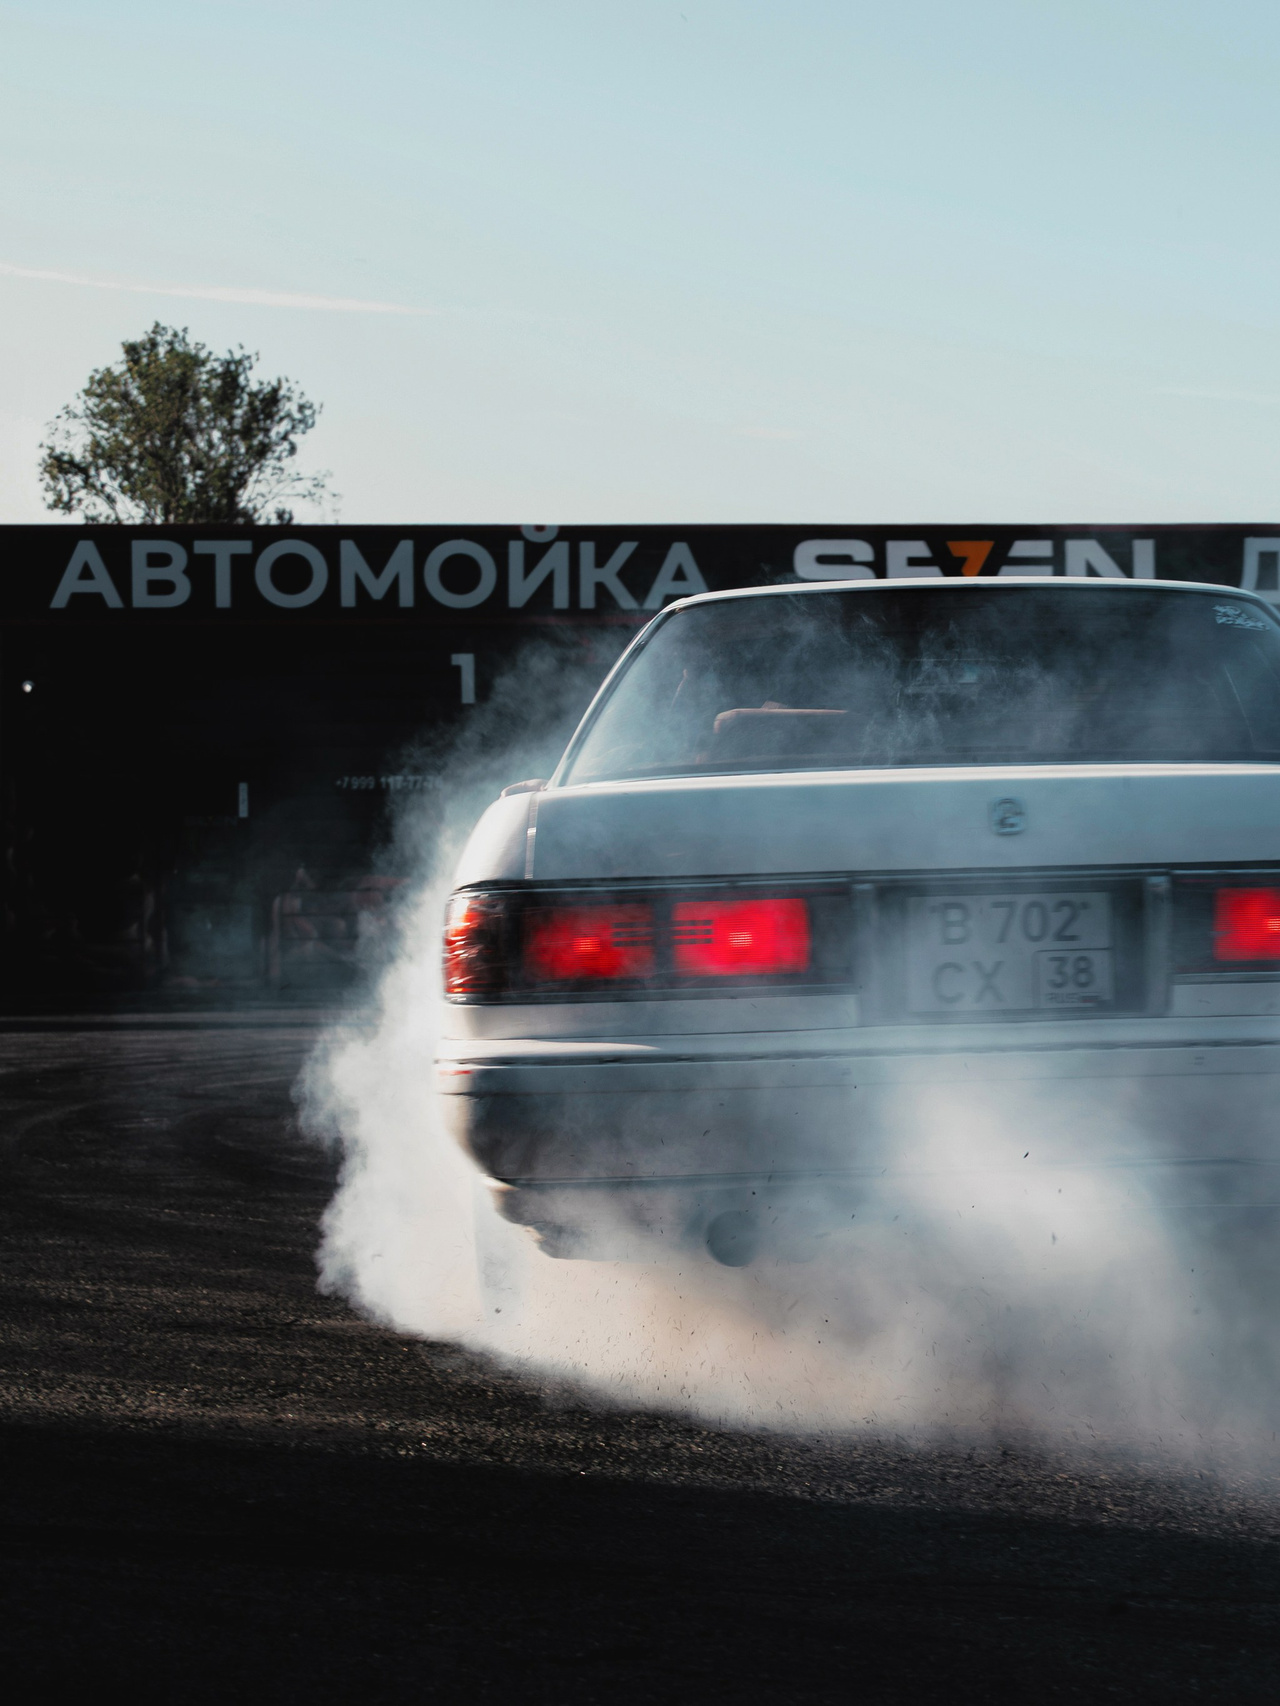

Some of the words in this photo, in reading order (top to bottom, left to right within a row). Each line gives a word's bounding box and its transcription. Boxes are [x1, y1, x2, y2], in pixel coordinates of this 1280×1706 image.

[50, 525, 709, 610] АВТОМОЙКА
[451, 653, 476, 704] 1
[990, 900, 1080, 944] 702
[932, 961, 1006, 1003] СХ
[1047, 956, 1096, 989] 38
